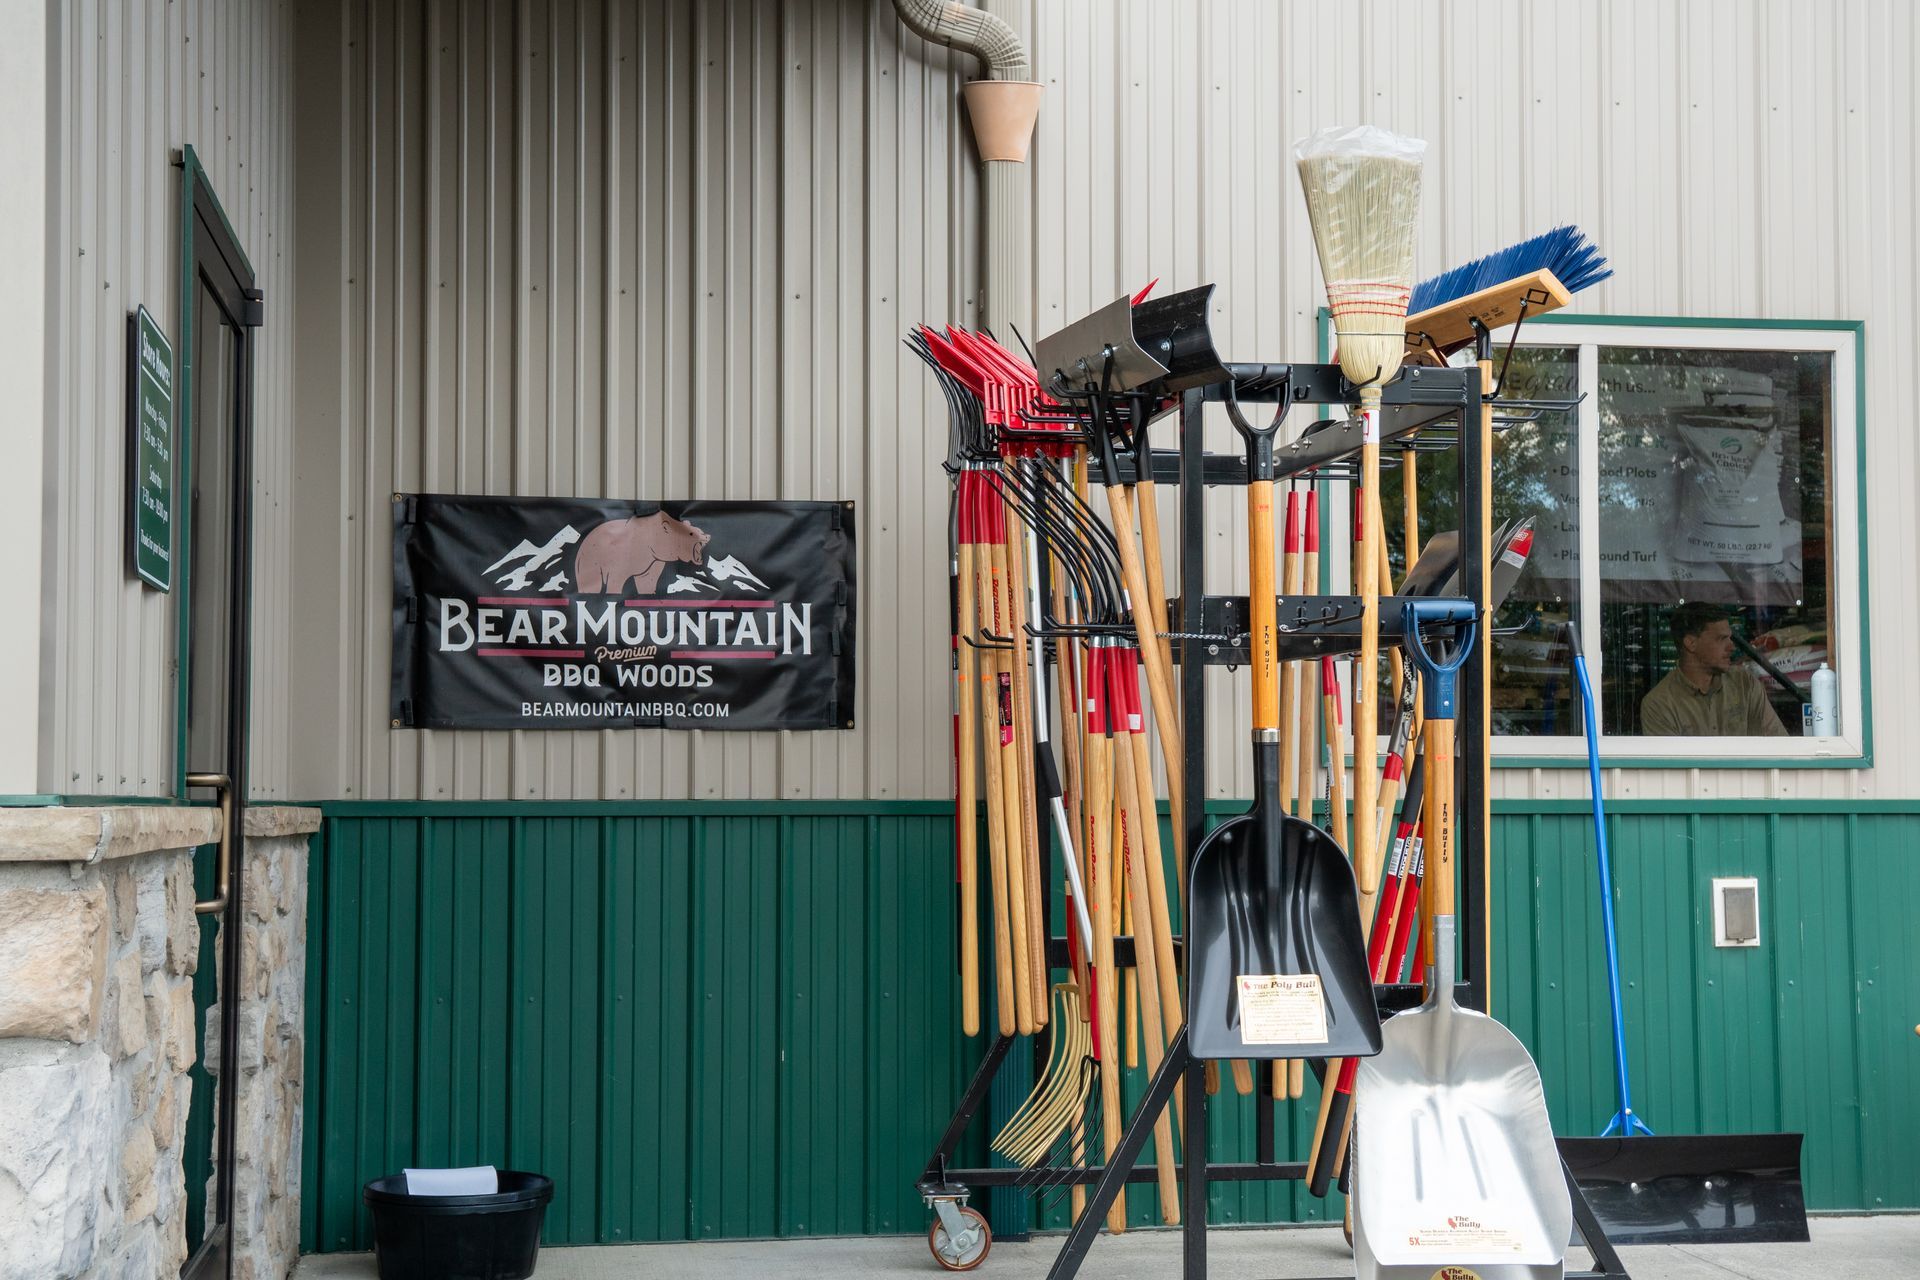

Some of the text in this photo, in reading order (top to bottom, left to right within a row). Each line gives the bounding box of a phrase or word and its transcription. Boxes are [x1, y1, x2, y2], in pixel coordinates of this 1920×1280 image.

[143, 331, 155, 369] Store
[1598, 378, 1622, 393] ith
[145, 396, 157, 426] Monday
[159, 411, 167, 438] Friday
[150, 464, 162, 494] Saturday
[1599, 466, 1623, 477] ood
[1626, 466, 1657, 478] Plots
[1632, 550, 1657, 562] Turf
[440, 597, 812, 655] BEAR MOUNTAIN
[594, 644, 657, 663] Premium
[543, 663, 714, 687] BBQ WOODS
[521, 702, 730, 718] BEARMOUNTAINBBQ.COM
[1271, 981, 1293, 990] Poly
[1296, 980, 1316, 989] Bull
[1458, 1221, 1481, 1229] Bully
[1409, 1237, 1421, 1246] 5X
